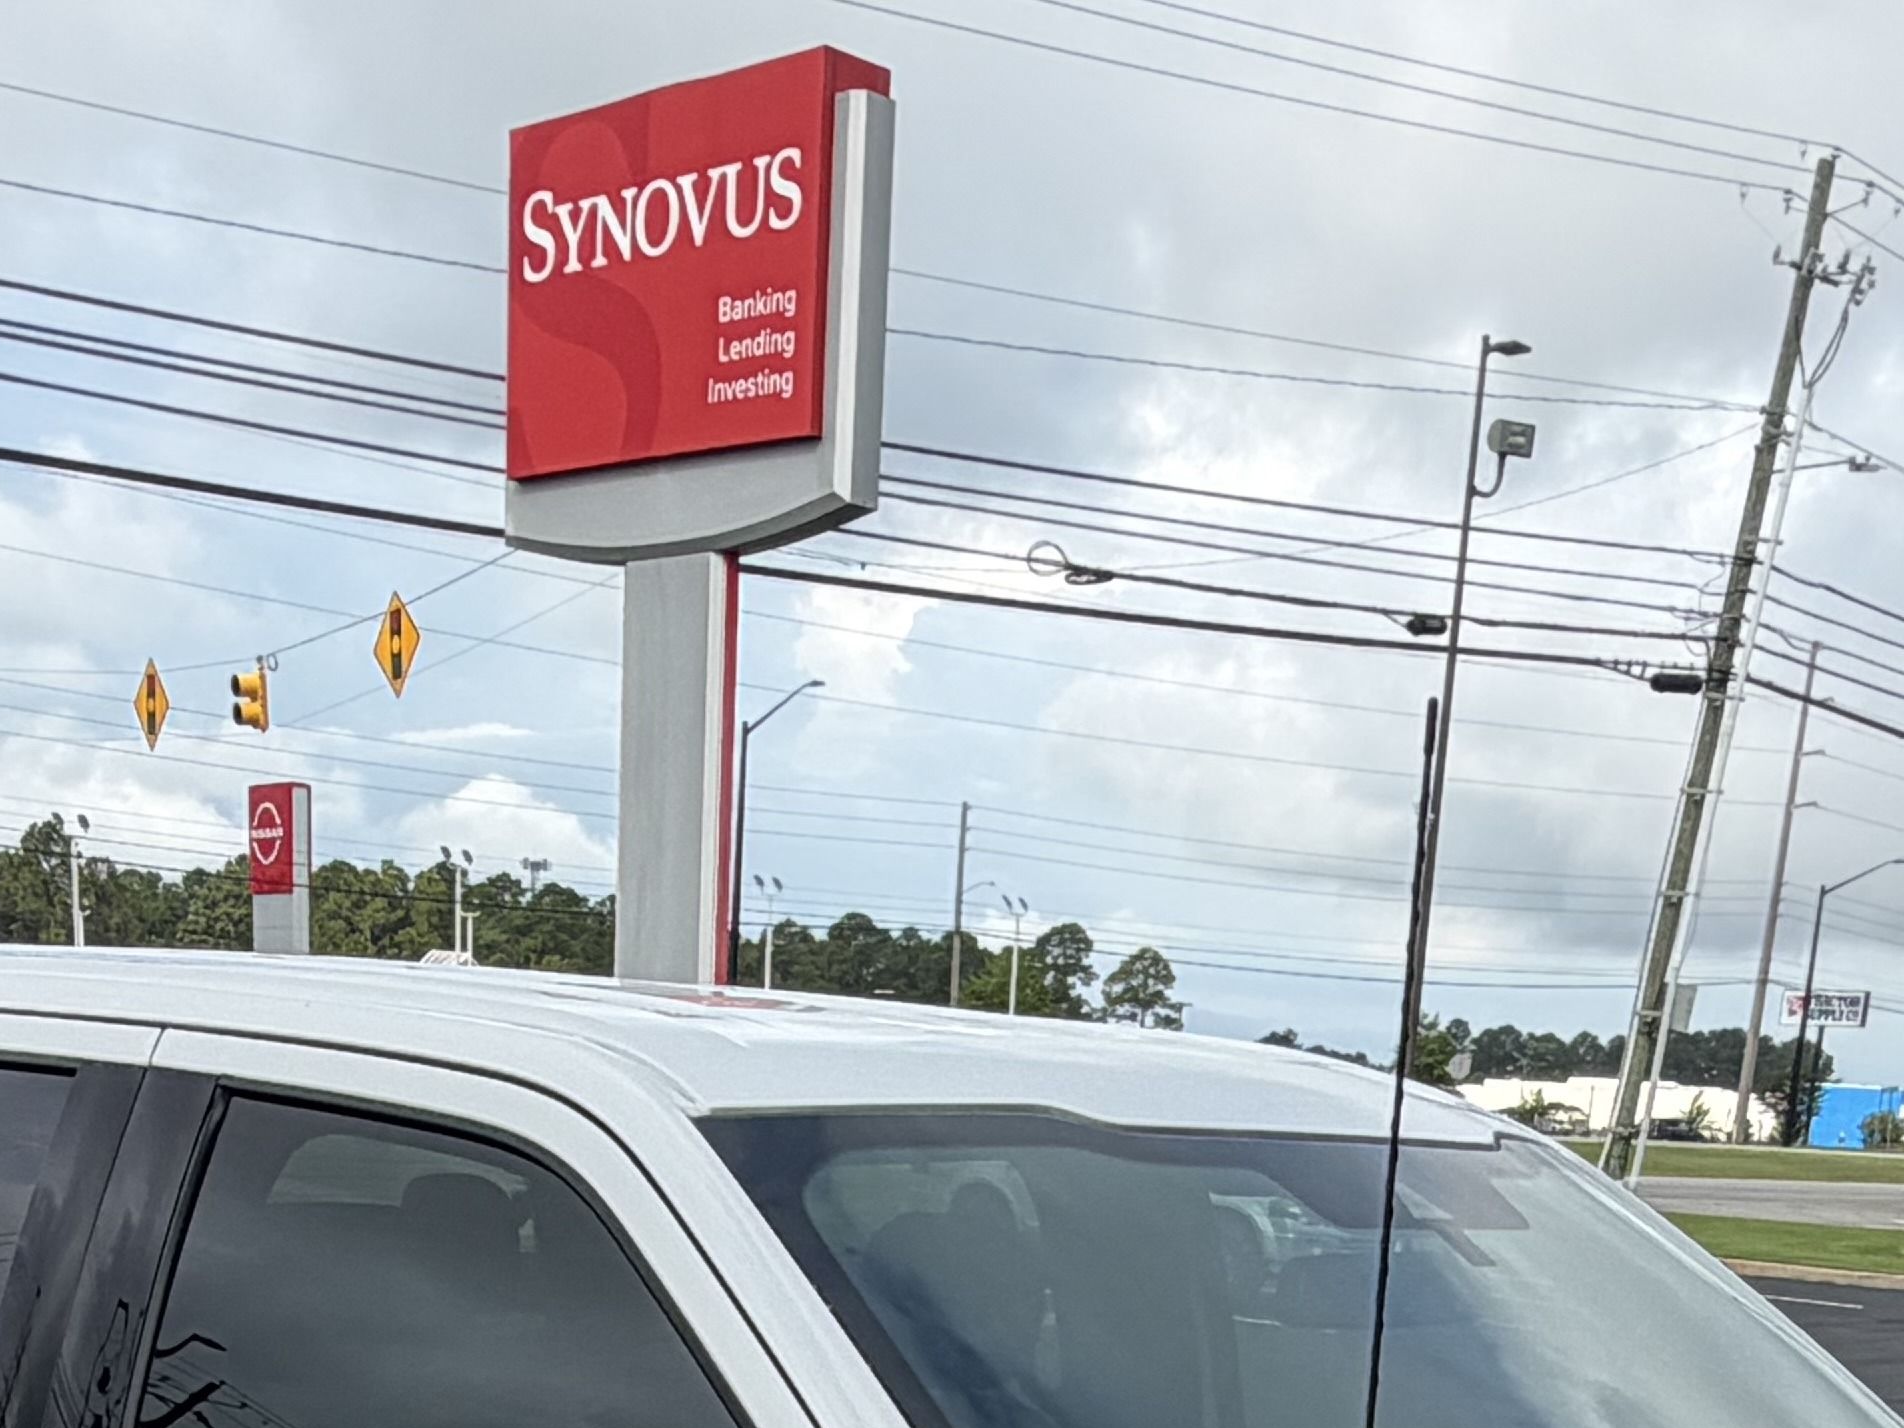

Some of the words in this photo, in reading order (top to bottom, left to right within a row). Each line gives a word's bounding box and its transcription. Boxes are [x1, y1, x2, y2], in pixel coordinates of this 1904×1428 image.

[522, 147, 802, 283] SYNOVUS
[717, 287, 797, 324] Banking
[717, 327, 796, 363] Lending
[706, 368, 794, 404] Investing
